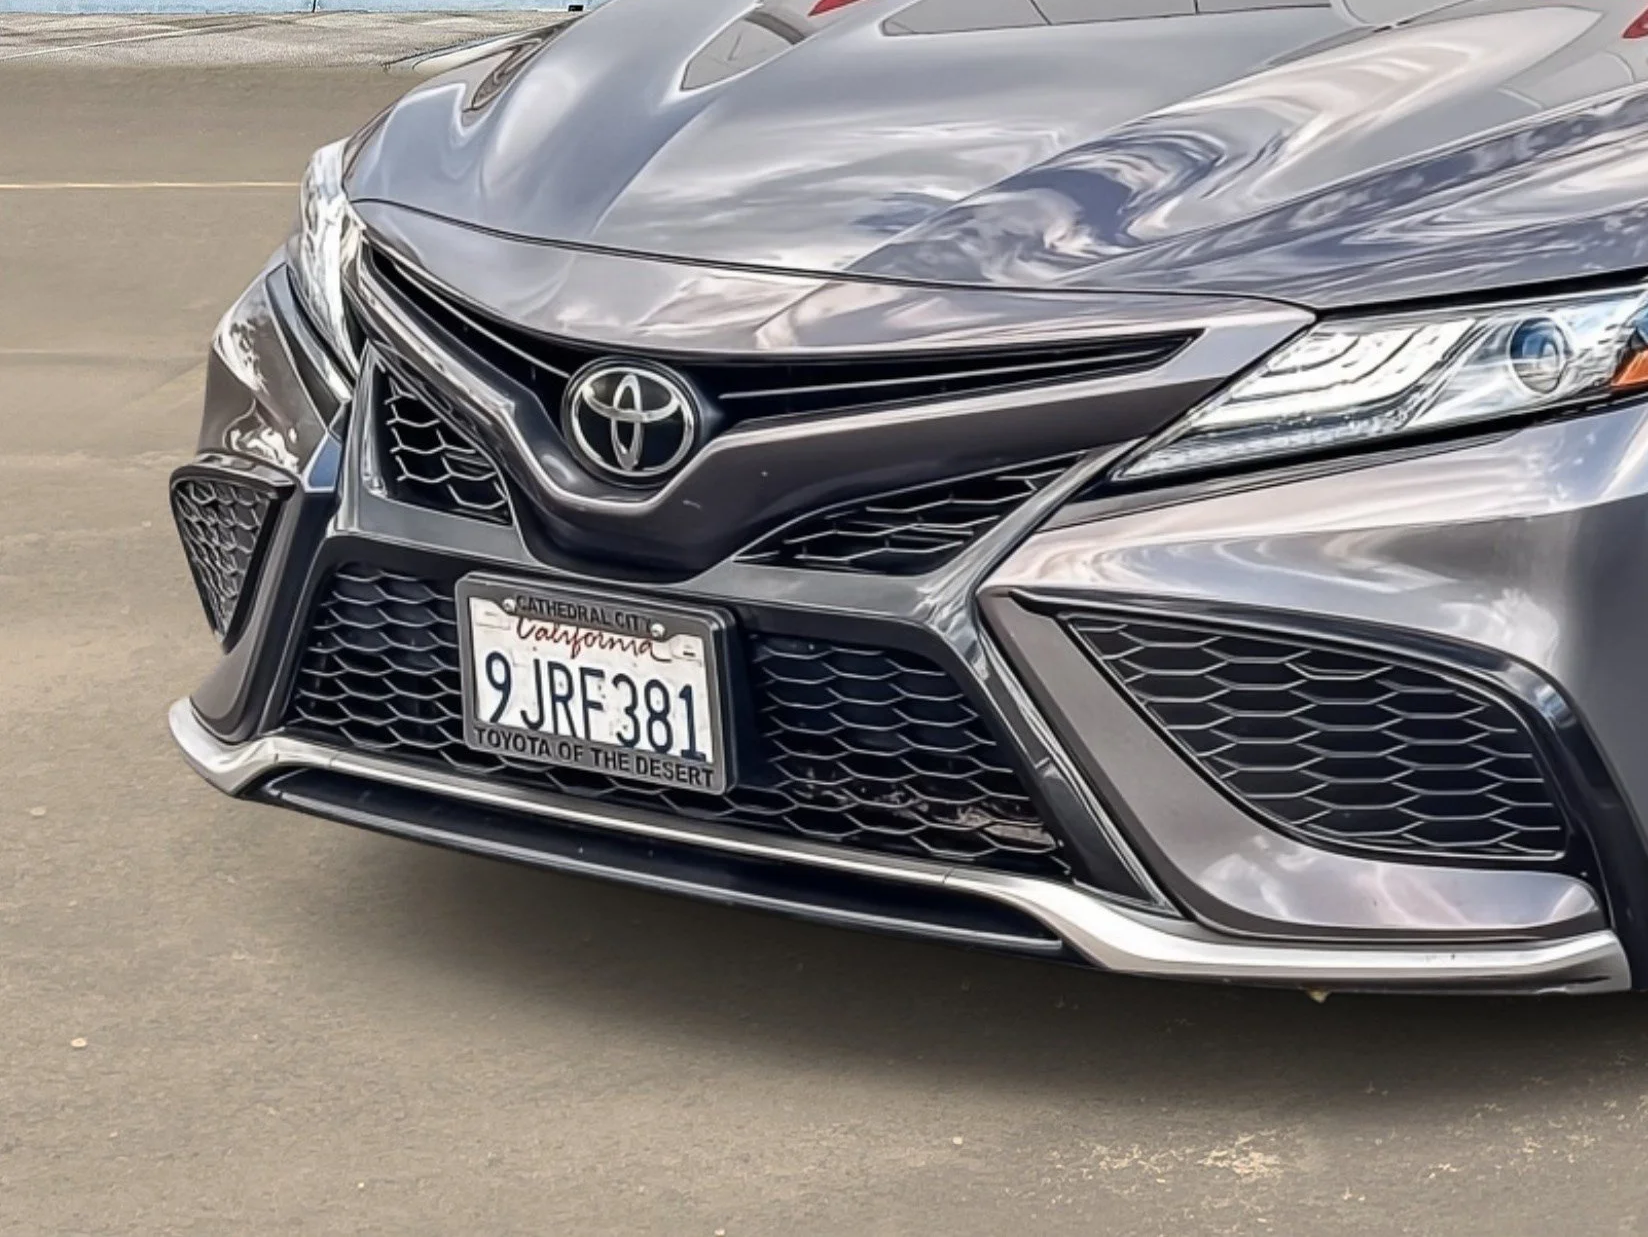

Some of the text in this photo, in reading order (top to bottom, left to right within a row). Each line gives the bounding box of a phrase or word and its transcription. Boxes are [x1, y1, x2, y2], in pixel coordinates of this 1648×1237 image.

[515, 594, 652, 632] CATHEDRAL CITY
[516, 616, 672, 662] California
[485, 650, 706, 762] 9JRF381
[473, 725, 715, 788] TOYOTA OF THE DESERT
